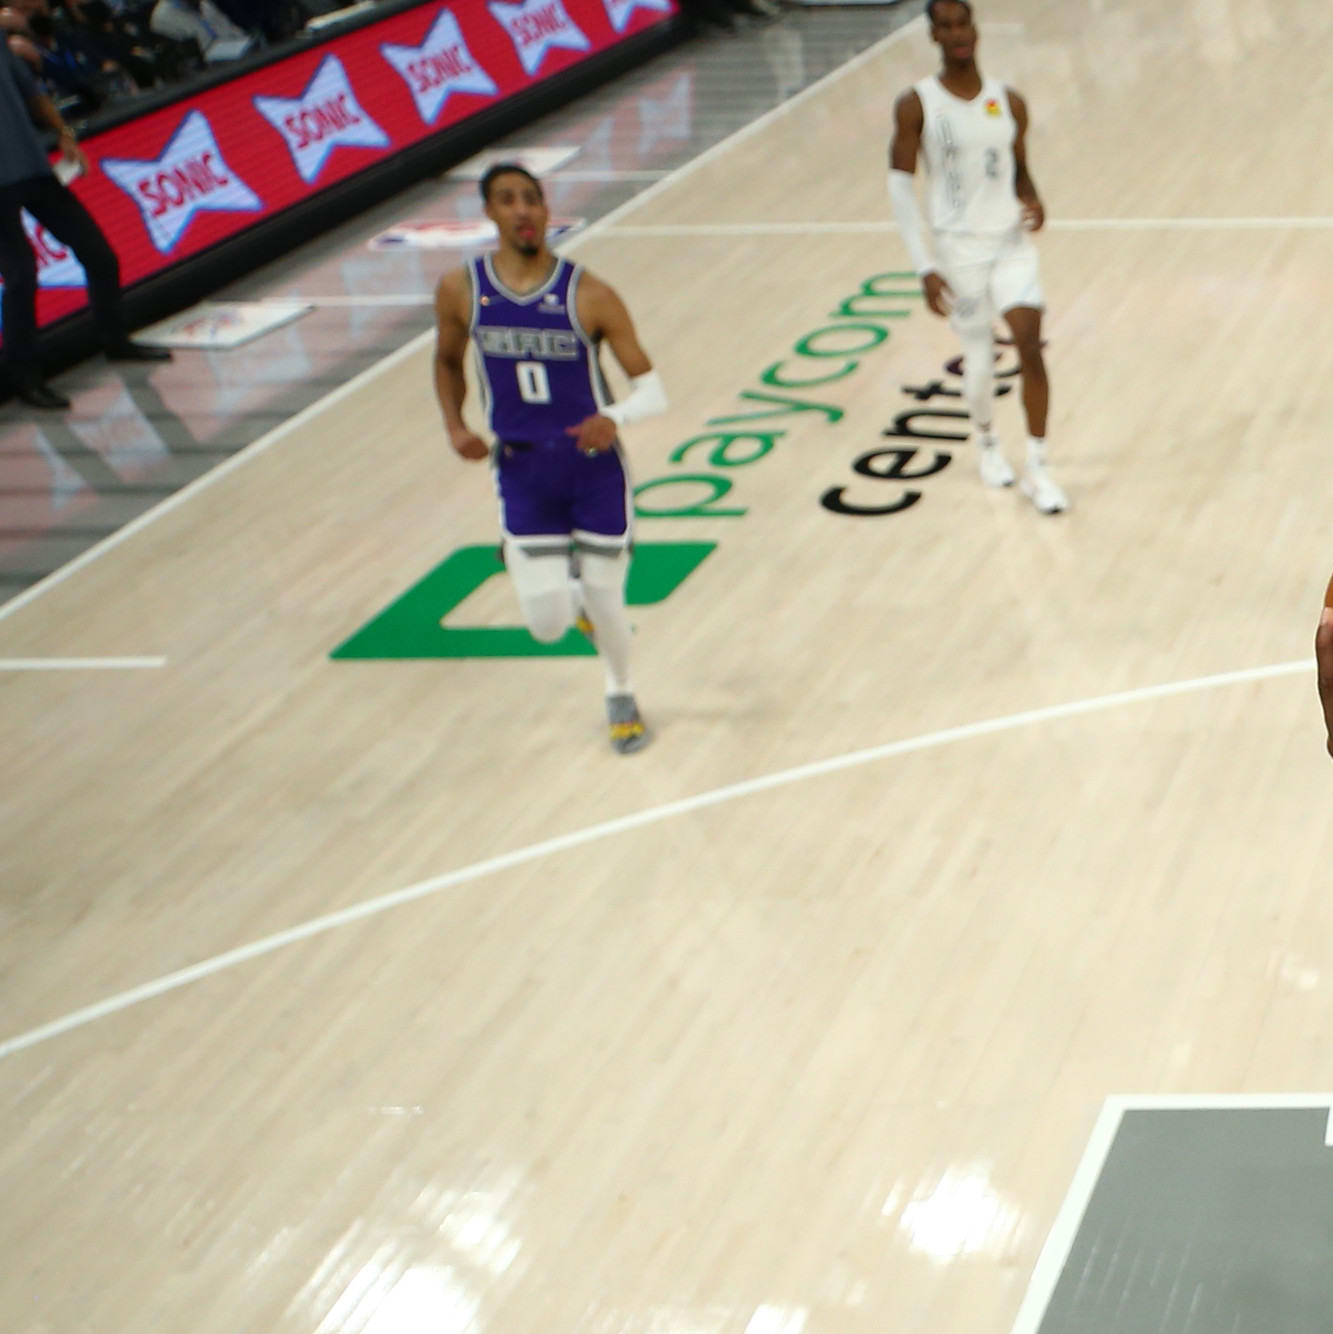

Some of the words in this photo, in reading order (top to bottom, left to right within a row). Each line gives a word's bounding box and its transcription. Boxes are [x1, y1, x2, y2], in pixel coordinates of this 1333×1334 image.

[284, 94, 362, 150] SONIC
[138, 153, 230, 219] SONIC
[516, 361, 552, 404] 0
[634, 271, 926, 518] paycom
[819, 338, 1048, 517] cent
